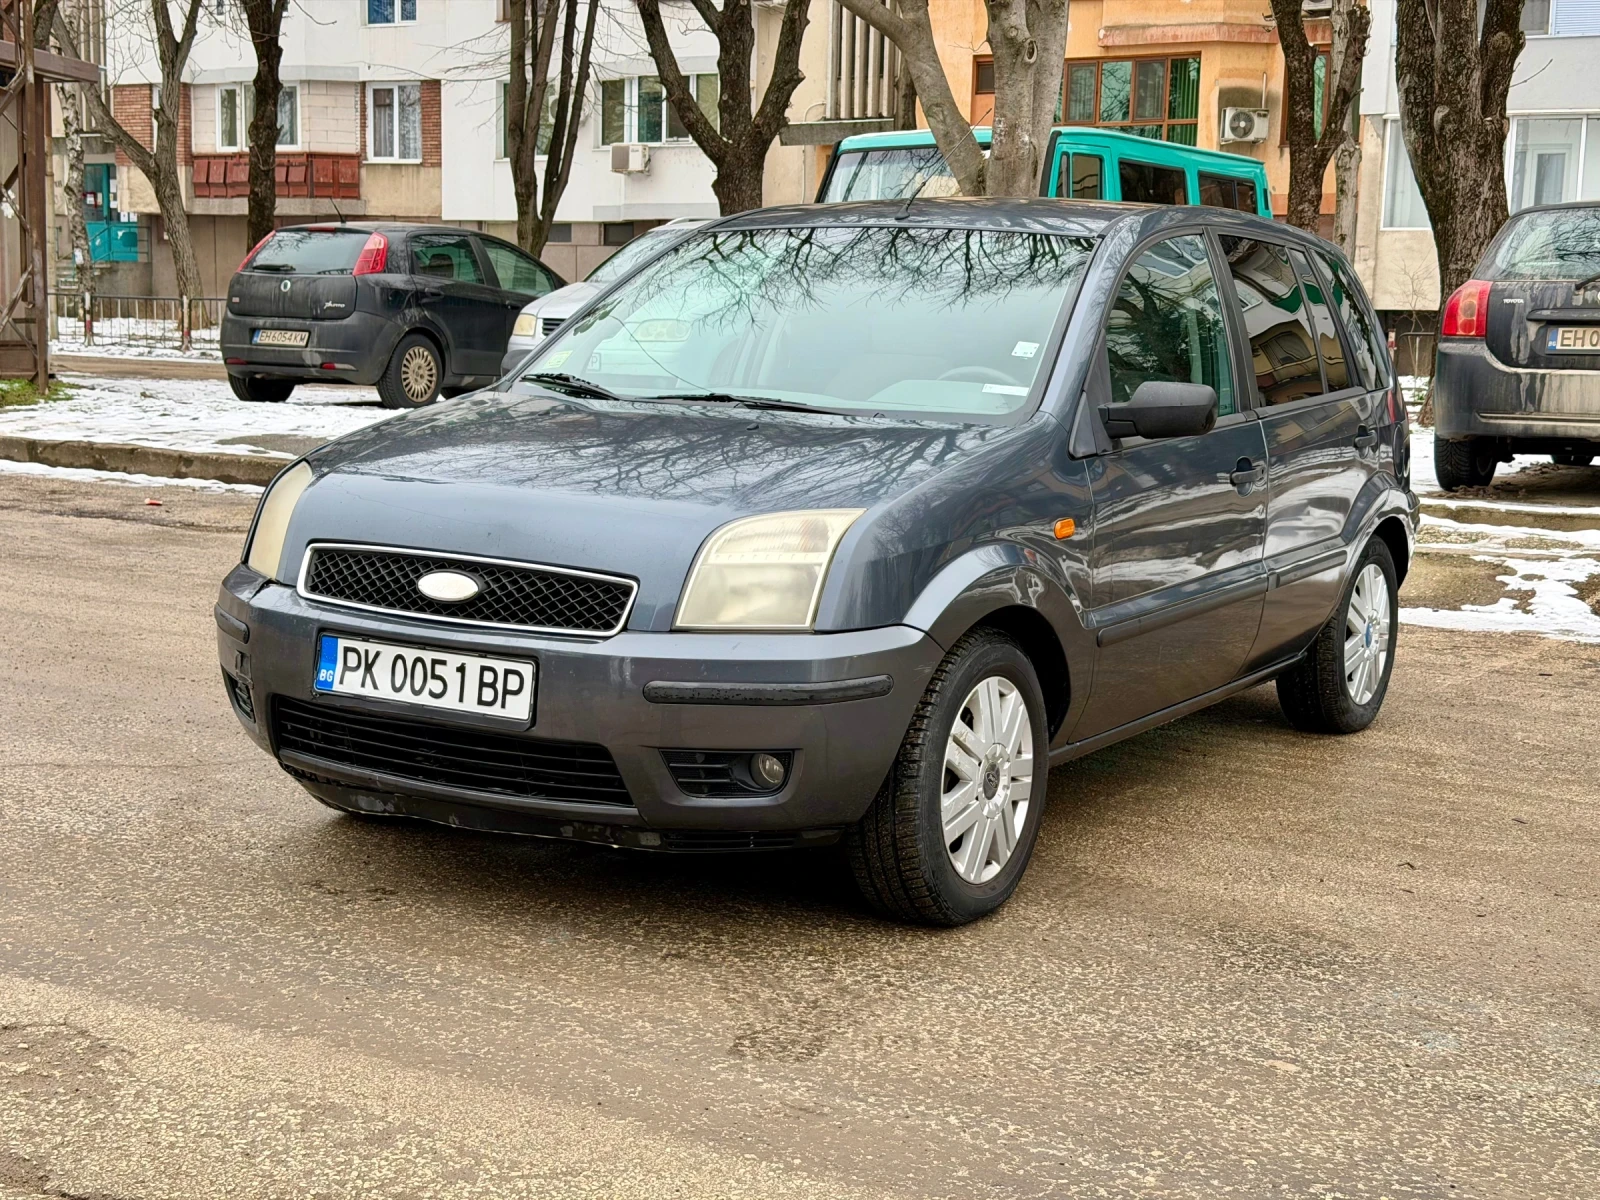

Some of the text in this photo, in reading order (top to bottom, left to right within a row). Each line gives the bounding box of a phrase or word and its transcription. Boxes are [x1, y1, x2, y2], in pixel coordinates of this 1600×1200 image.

[1560, 330, 1586, 347] EH
[320, 669, 334, 682] BG
[339, 646, 525, 709] PK 0051 BP
